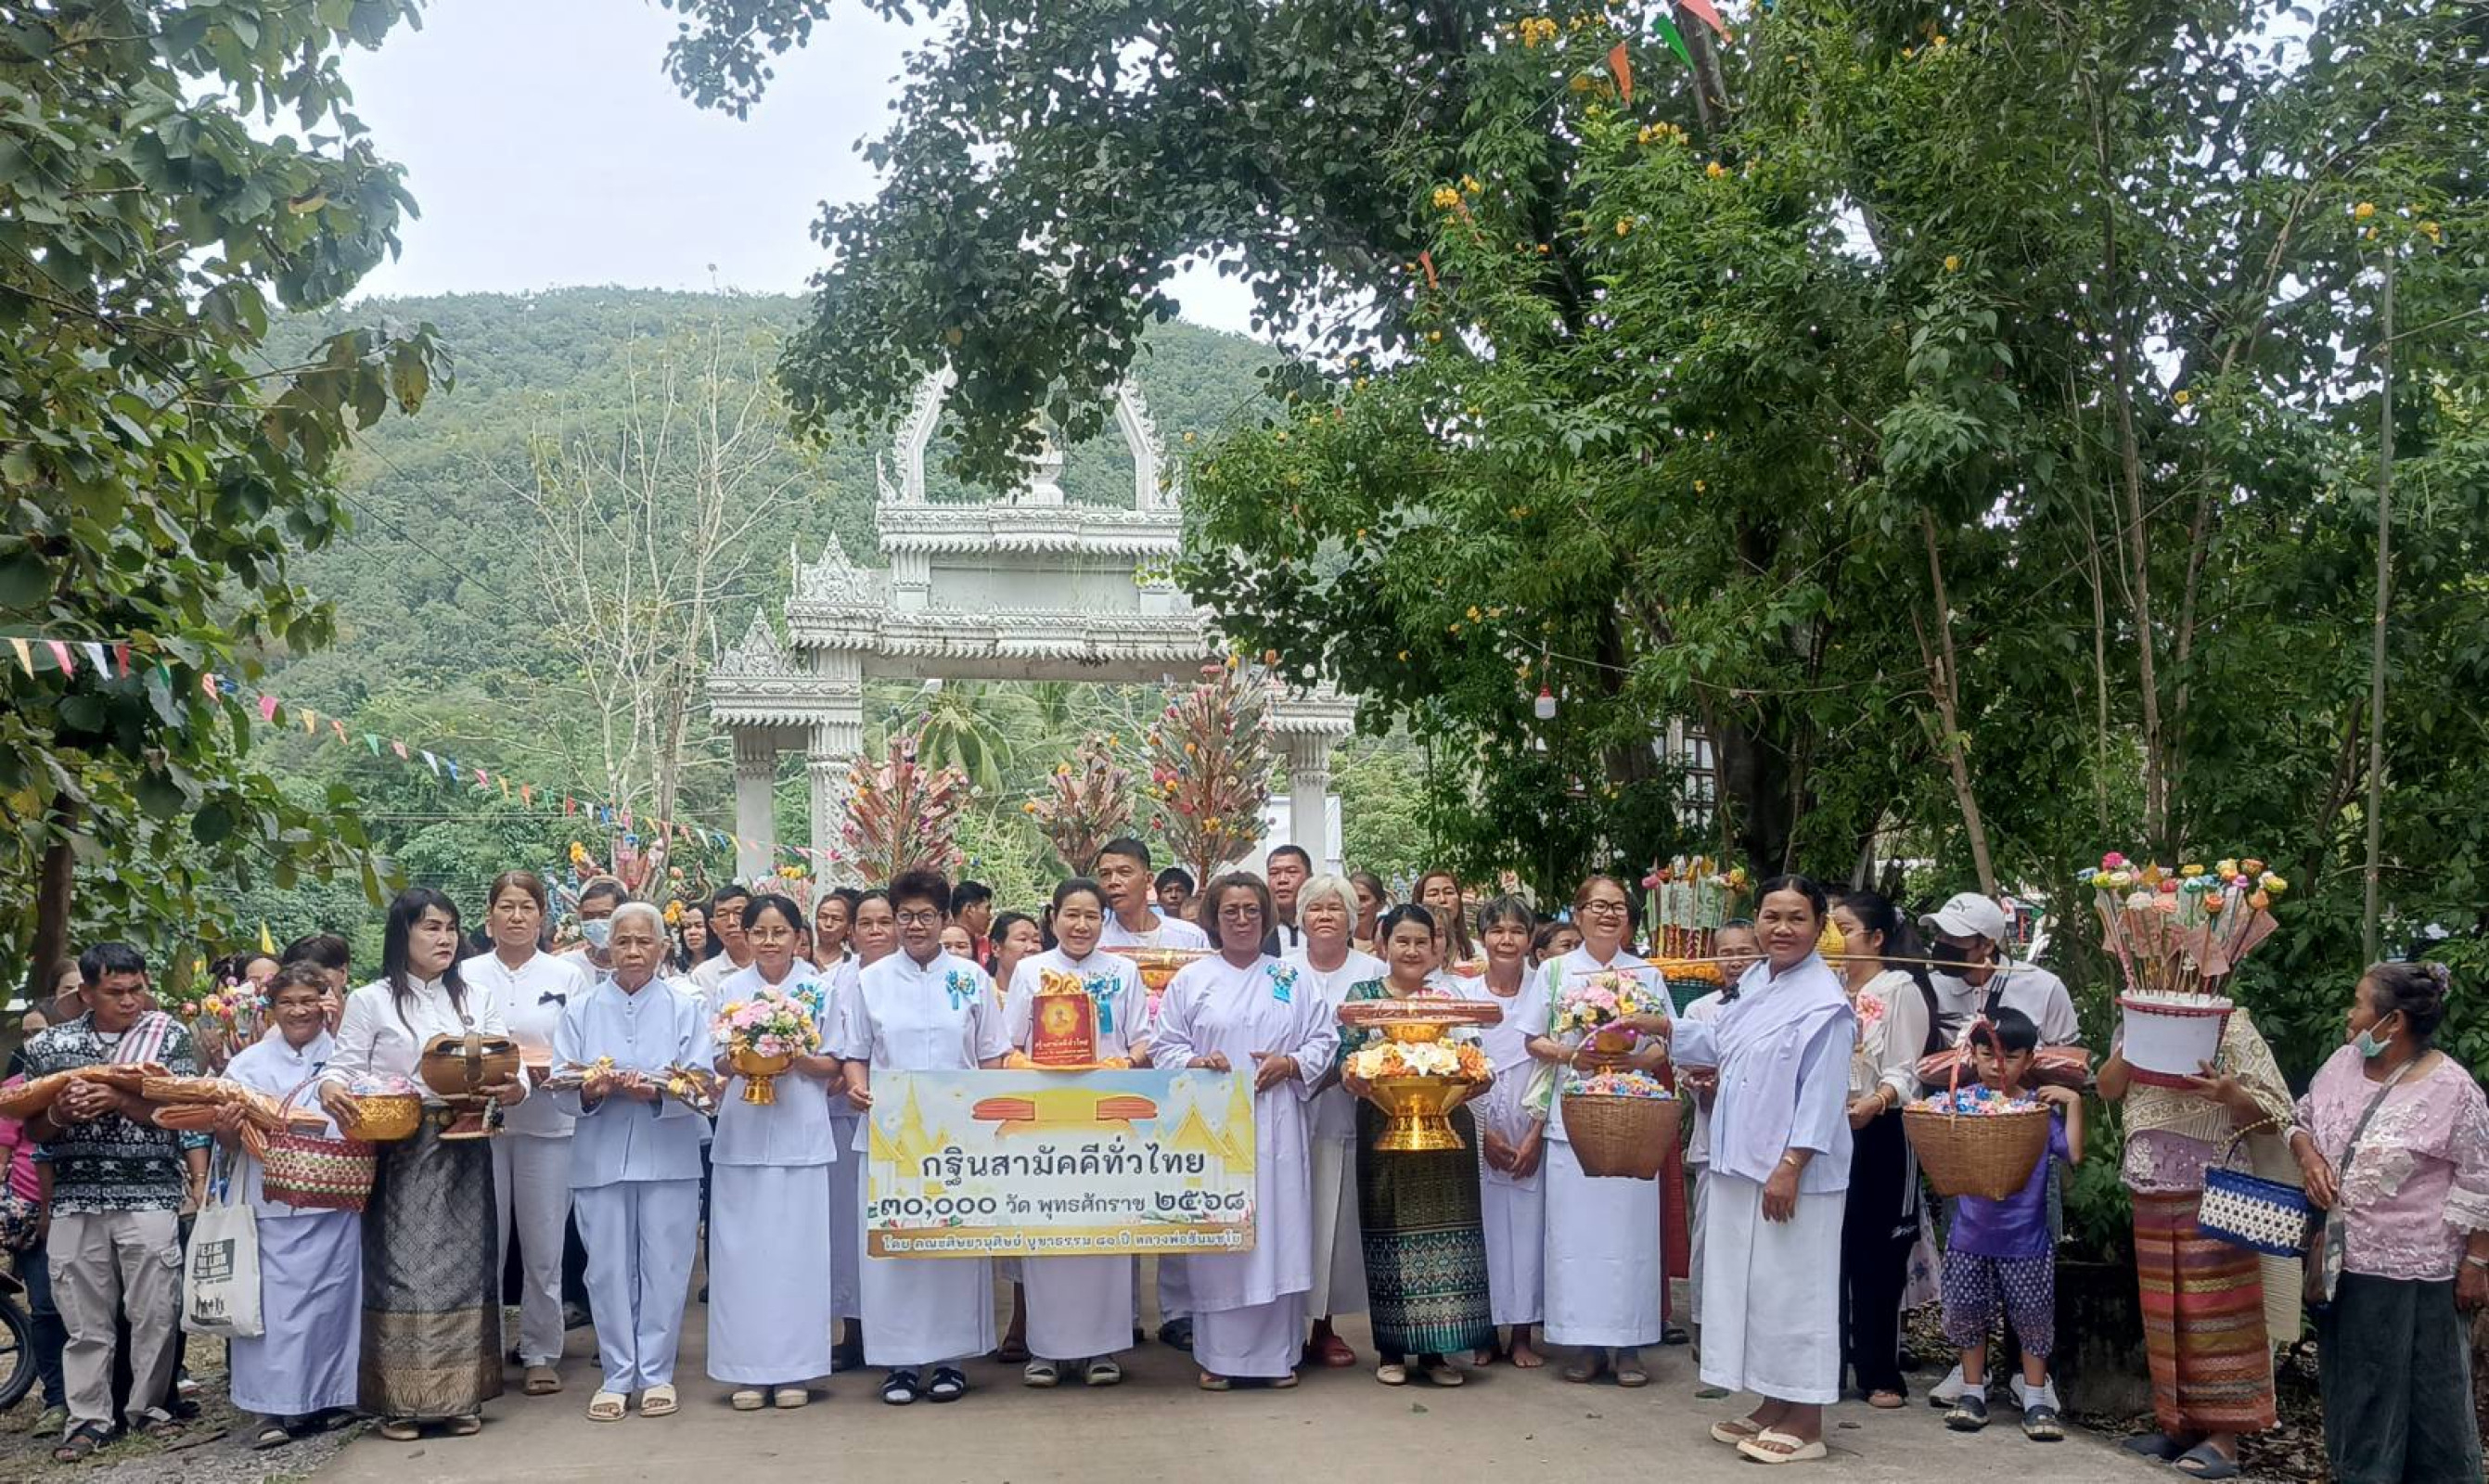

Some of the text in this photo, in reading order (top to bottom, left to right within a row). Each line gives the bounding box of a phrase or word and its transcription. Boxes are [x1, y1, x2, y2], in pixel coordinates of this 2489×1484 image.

[922, 1136, 1204, 1186] กฐินสามัคคีทั่วไทย
[880, 1190, 1244, 1220] ๓๐,๐๐๐ วัด พุทธศักราช ๒๕๖๘
[883, 1235, 910, 1250] โดย
[915, 1234, 1022, 1253] คณะศิษยานุศิษย์
